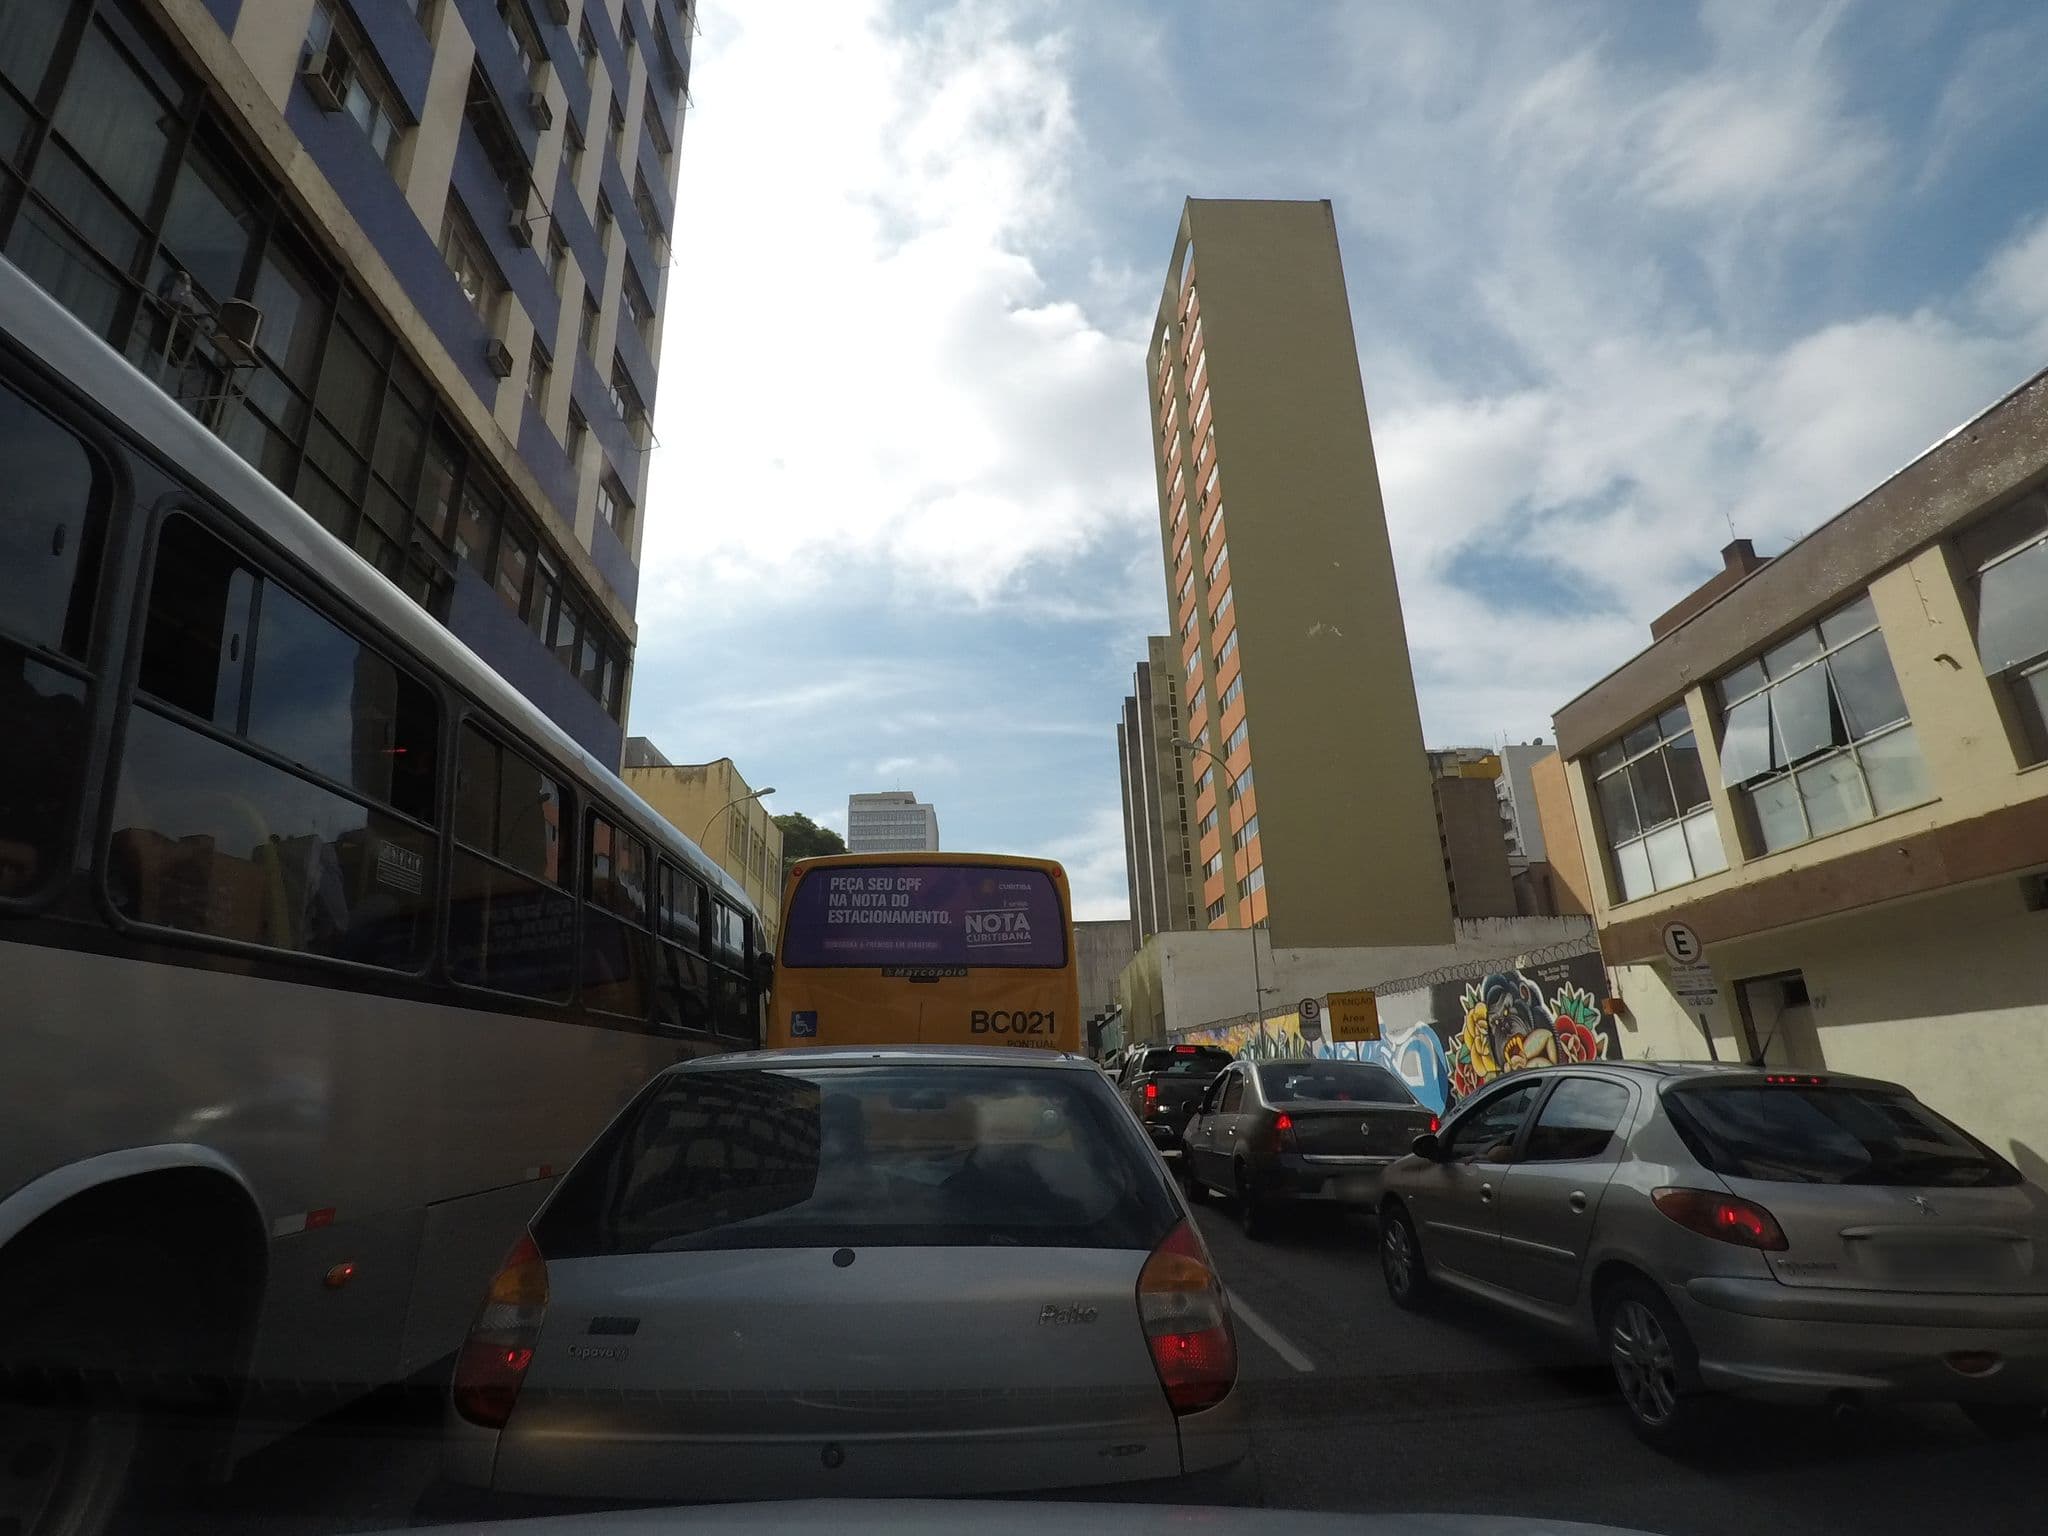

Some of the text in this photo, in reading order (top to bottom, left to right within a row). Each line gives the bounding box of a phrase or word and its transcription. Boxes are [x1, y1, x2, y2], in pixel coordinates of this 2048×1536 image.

[830, 877, 922, 893] PEÇA SEU CPF
[829, 893, 910, 907] NA NOTA DO
[828, 909, 952, 924] ESTACIONAMENTO.
[964, 912, 1031, 934] NOTA
[966, 931, 1032, 943] CURITIBANA
[1671, 930, 1691, 955] E
[893, 968, 966, 977] Marcopolo
[1305, 1002, 1313, 1015] E
[1330, 996, 1374, 1007] ATENÇÃO
[971, 1010, 1055, 1034] BC021
[1039, 1303, 1098, 1325] Palio
